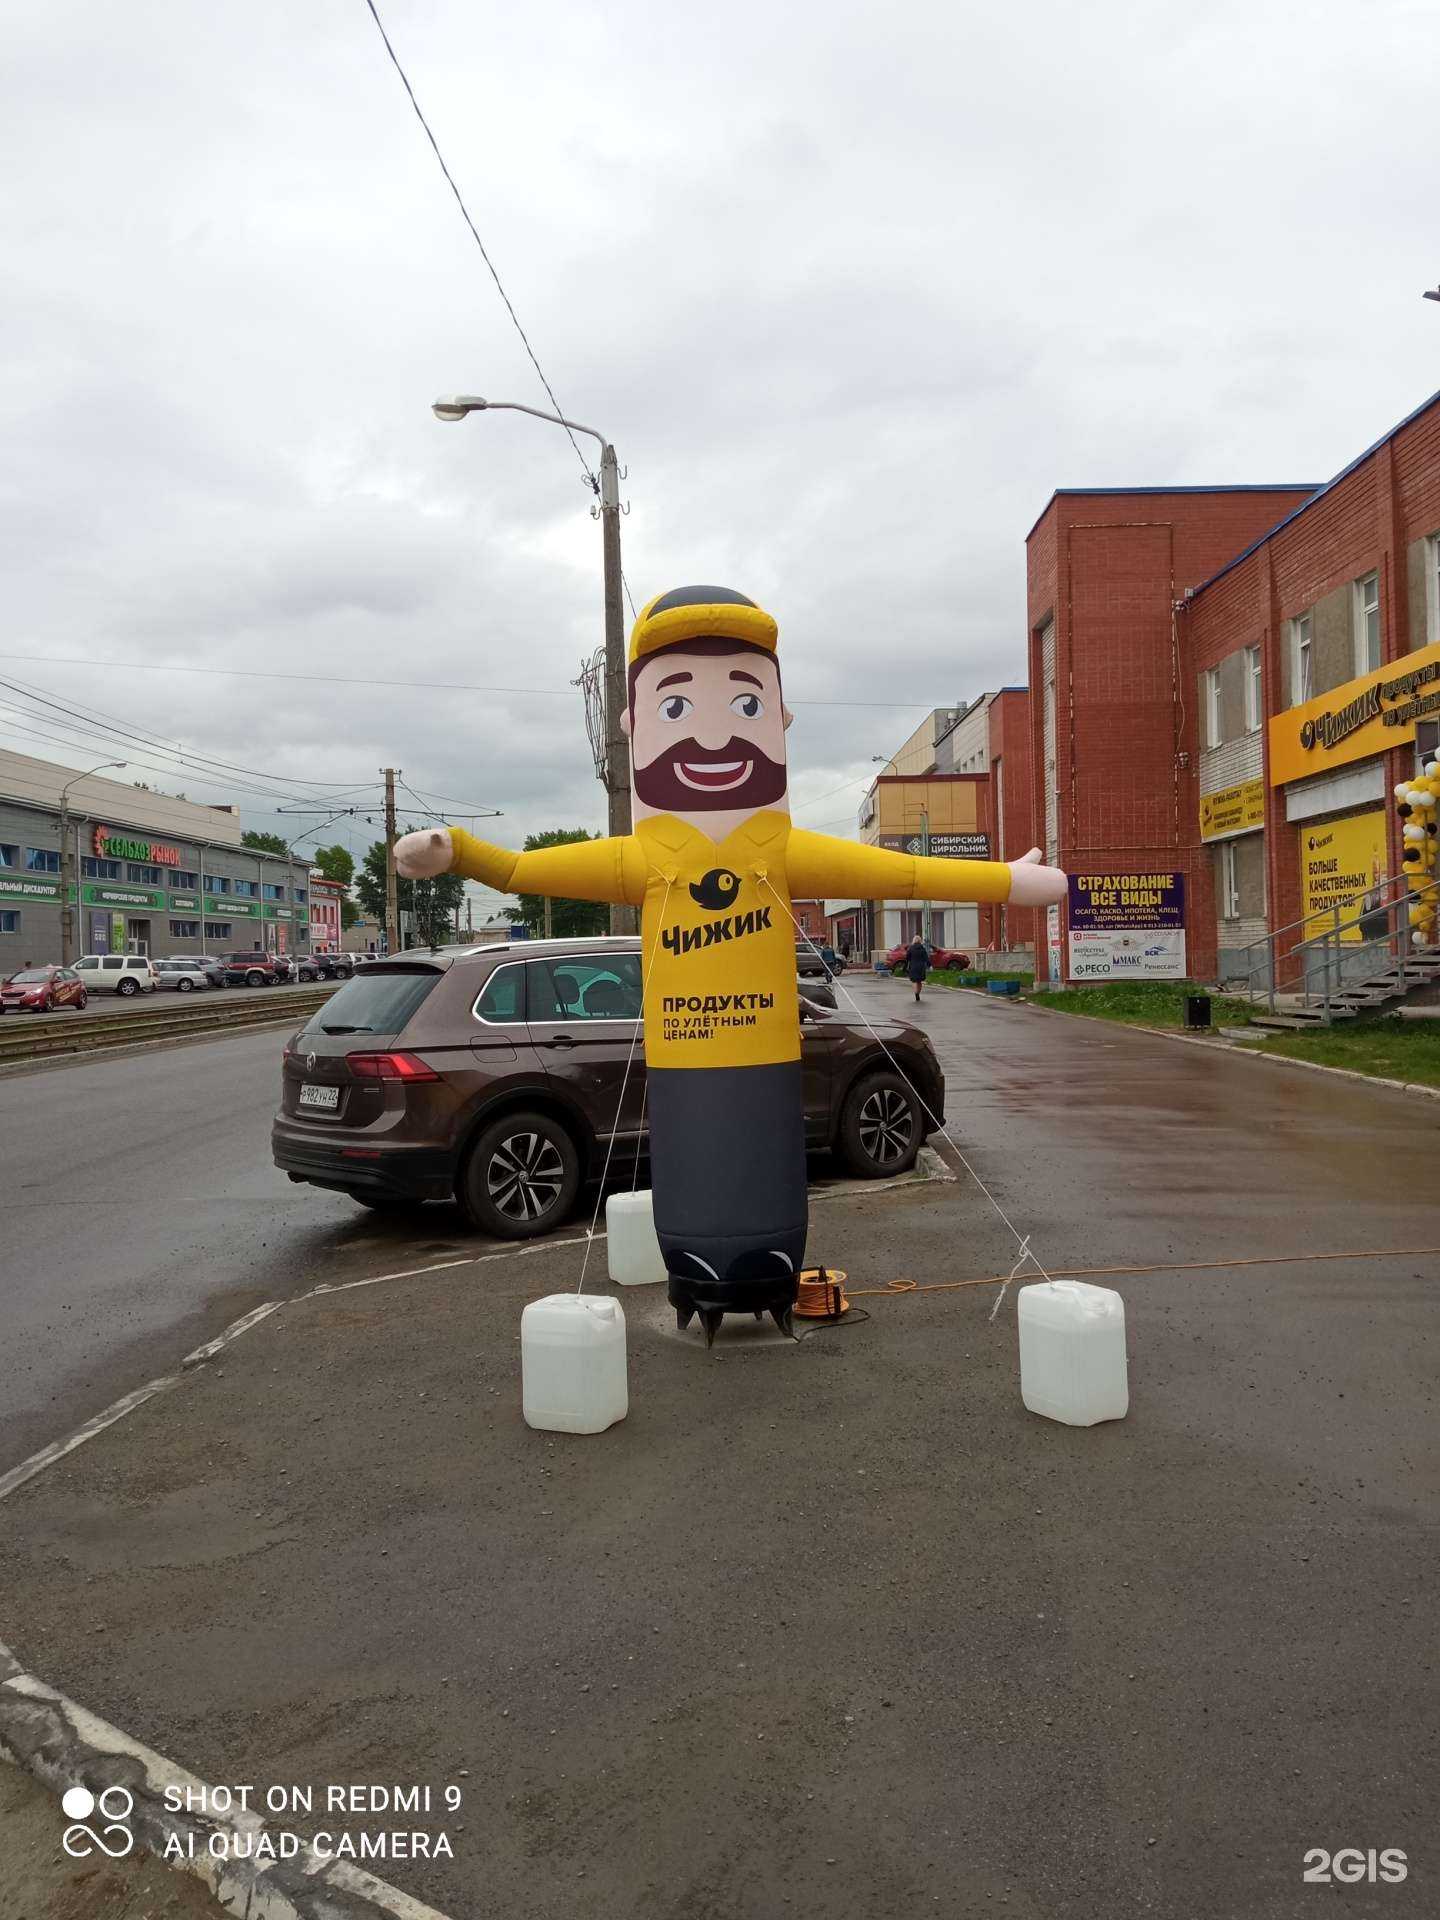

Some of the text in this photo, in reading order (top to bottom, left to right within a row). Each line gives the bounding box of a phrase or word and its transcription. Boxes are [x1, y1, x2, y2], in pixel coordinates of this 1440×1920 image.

[931, 835, 986, 845] СИБИРСКИЙ
[931, 845, 988, 853] ЦИРЮЛЬНИК
[1309, 858, 1338, 875] БОЛЬШЕ
[1077, 875, 1174, 890] СТРАХОВАНИЕ
[1309, 873, 1366, 893] КАЧЕСТВЕННЫХ
[1091, 890, 1162, 907] ВСЕ ВИДЫ
[1125, 907, 1157, 915] ИПОТЕКА,
[1120, 956, 1142, 965] МАКС
[1085, 964, 1111, 973] РЕСО
[662, 993, 774, 1013] ПРОДУКТЫ
[663, 1014, 757, 1029] ПО УЛЁТНЫМ
[663, 1028, 714, 1041] ЦЕНАМ!
